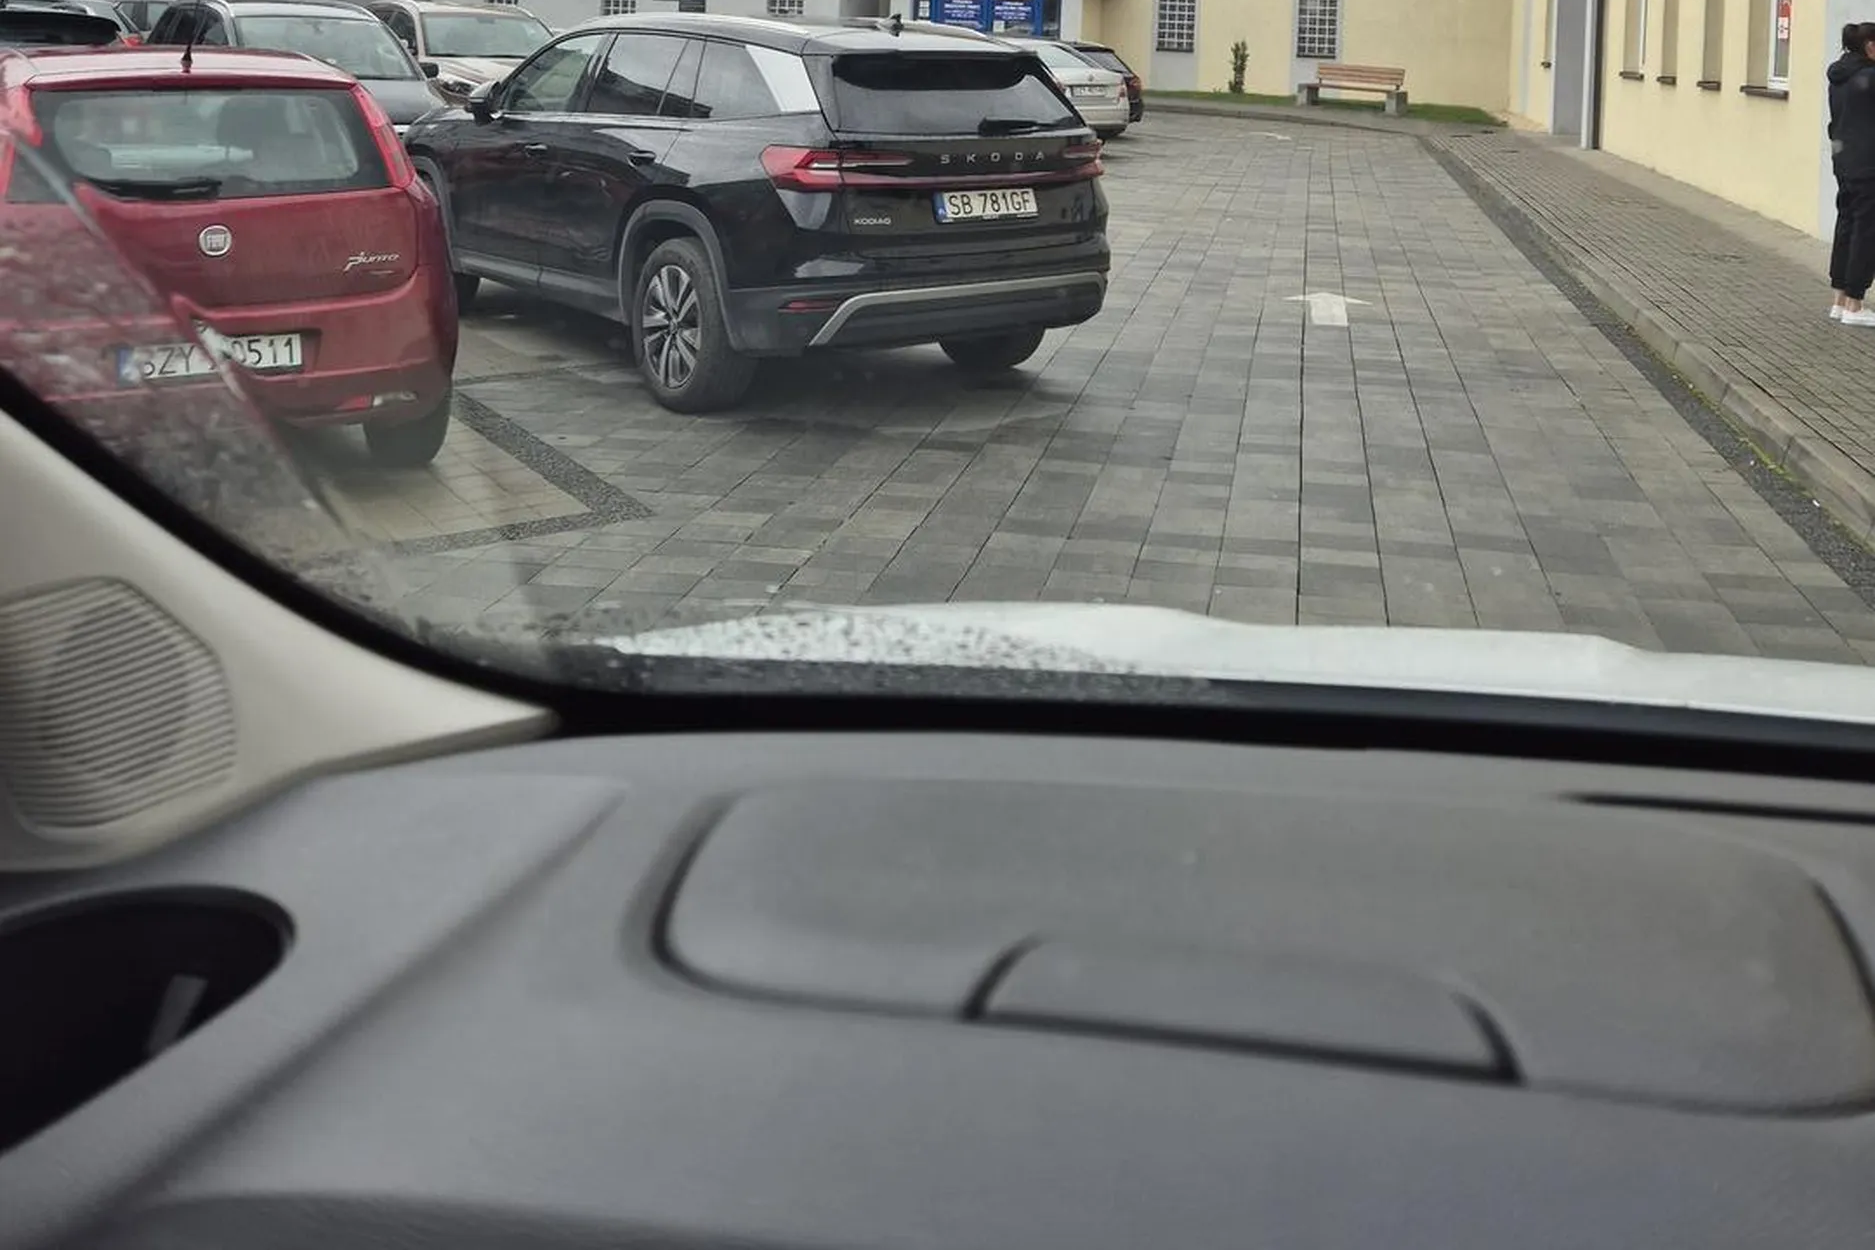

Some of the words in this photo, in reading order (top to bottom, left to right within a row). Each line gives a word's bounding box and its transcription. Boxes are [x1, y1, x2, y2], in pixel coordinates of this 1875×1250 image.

[940, 152, 1045, 165] SKODA
[950, 195, 973, 216] SB
[980, 191, 1031, 214] 781GF
